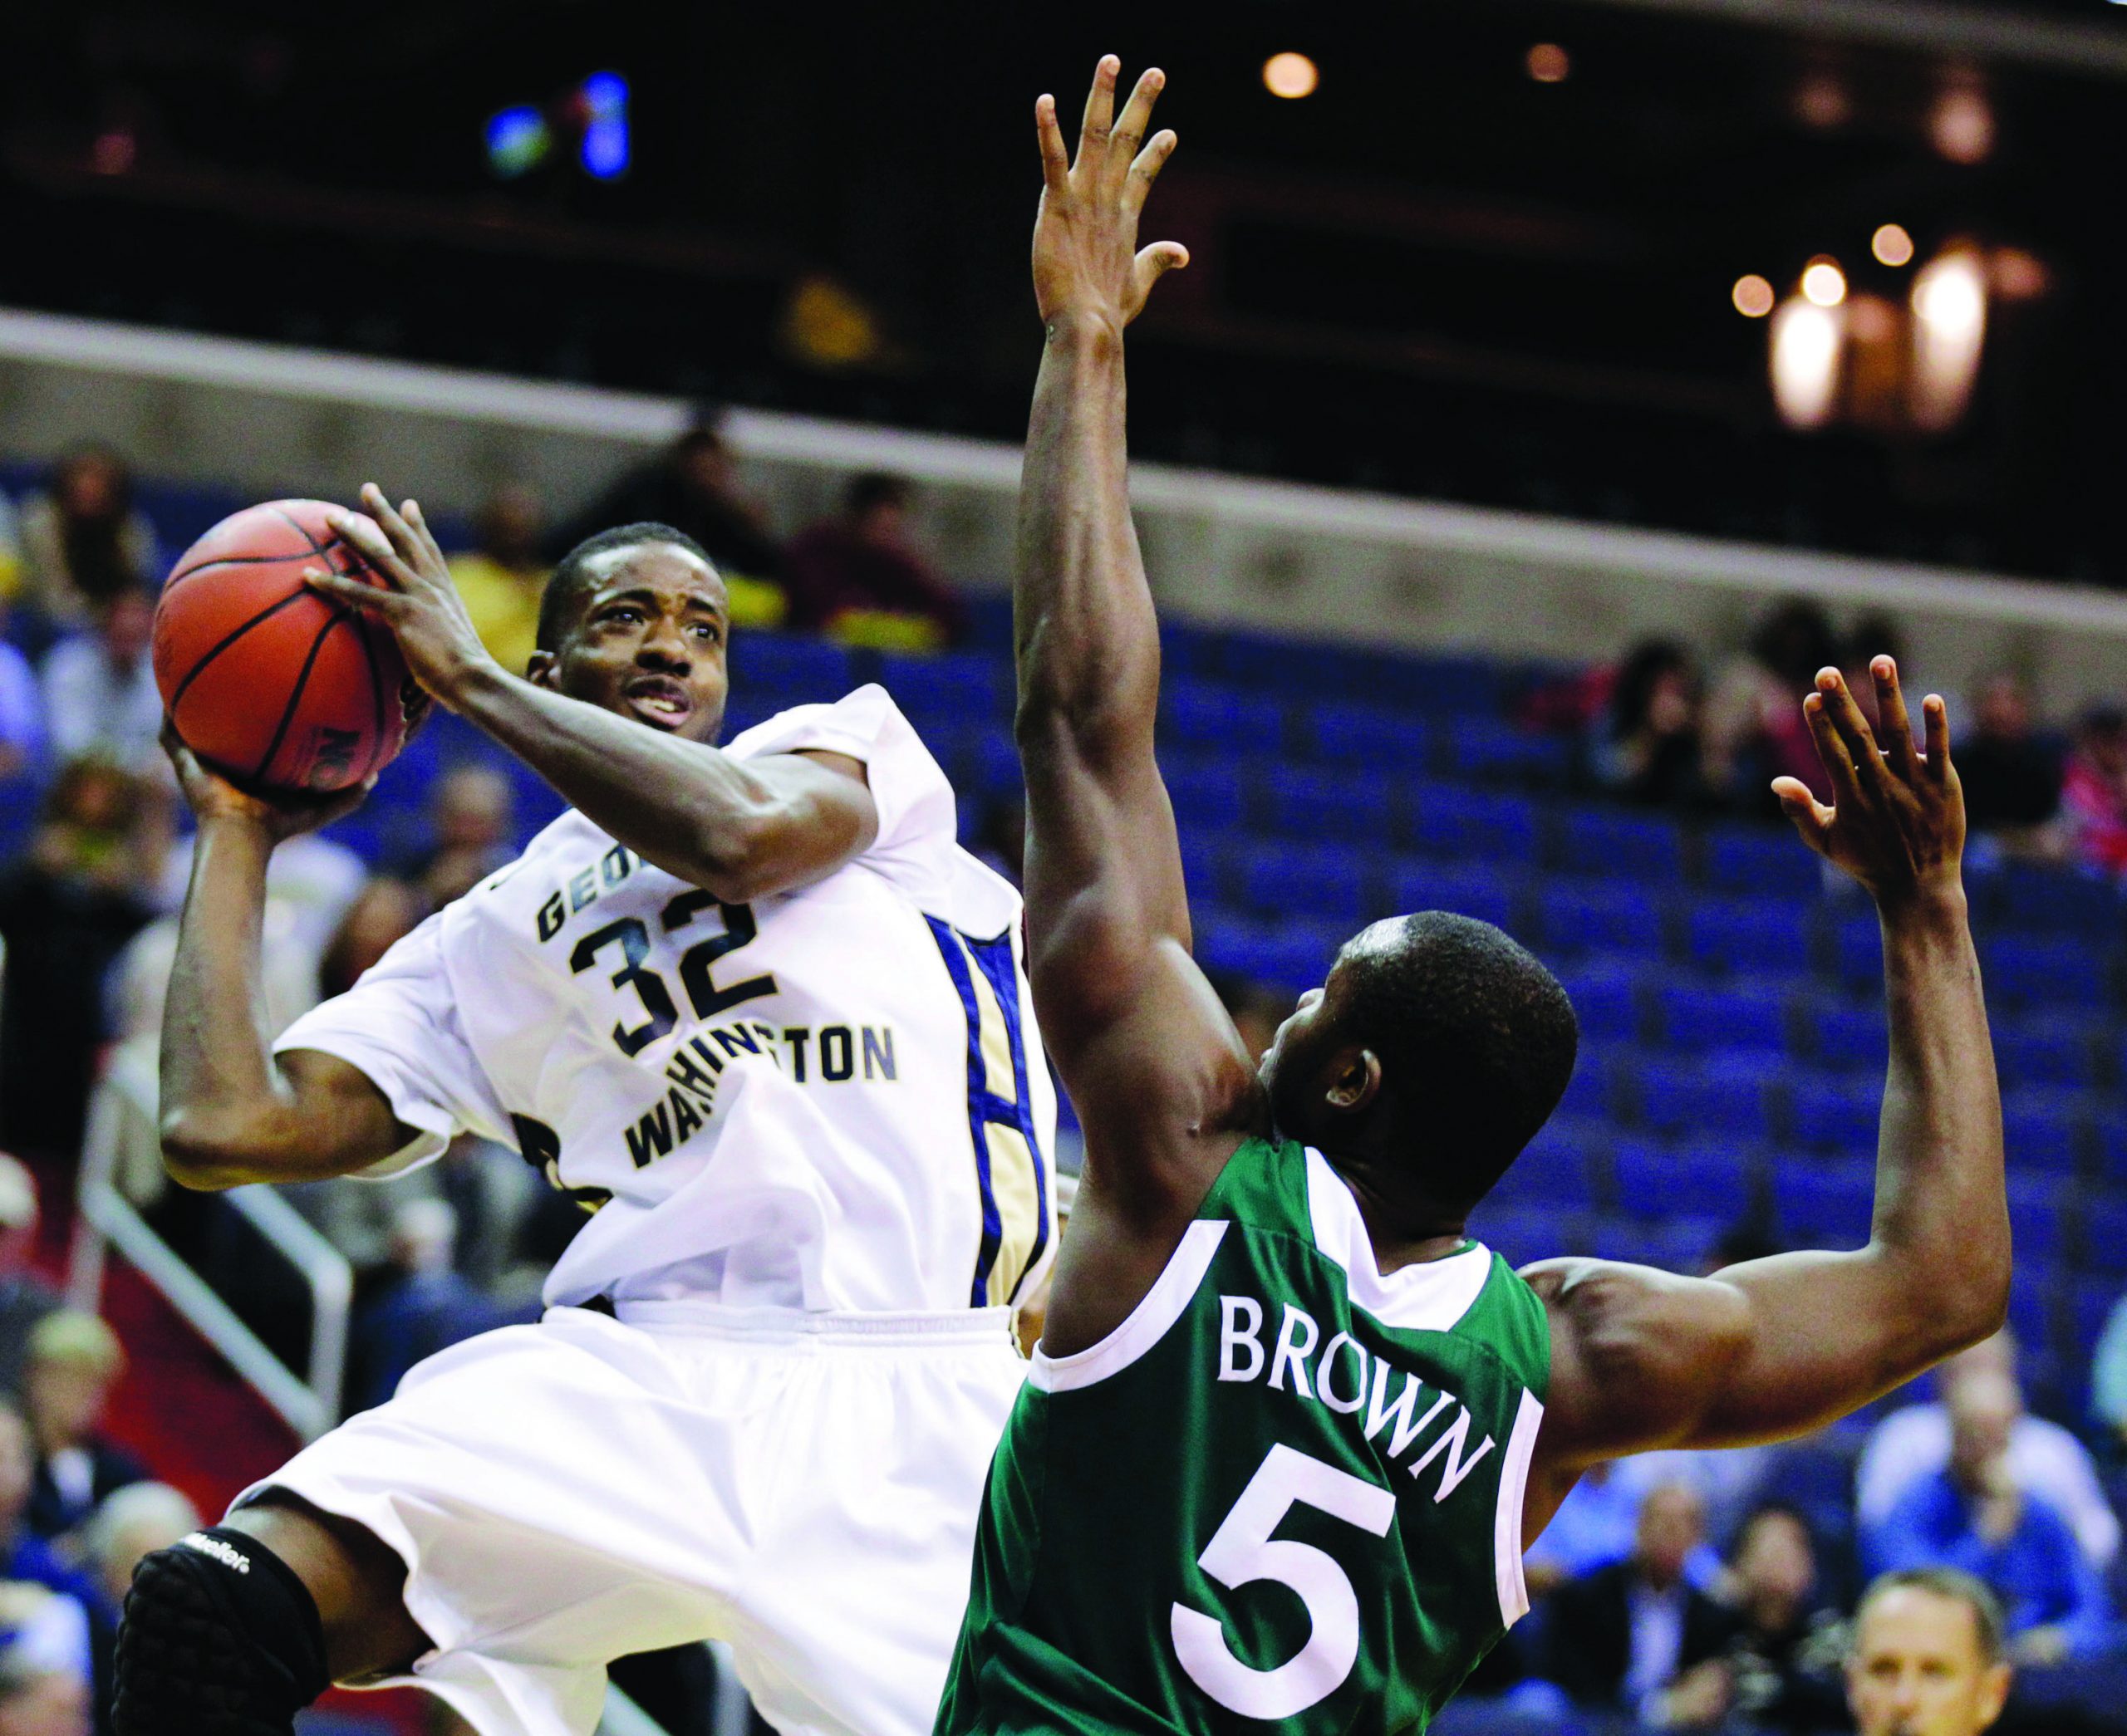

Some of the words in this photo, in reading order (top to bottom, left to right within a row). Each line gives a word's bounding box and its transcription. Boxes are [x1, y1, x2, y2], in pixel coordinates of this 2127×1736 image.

[536, 842, 652, 944] GEO
[569, 887, 780, 1058] 32
[623, 1020, 899, 1171] WAHINTON
[1217, 1295, 1496, 1503] BROWN
[1171, 1442, 1397, 1720] 5
